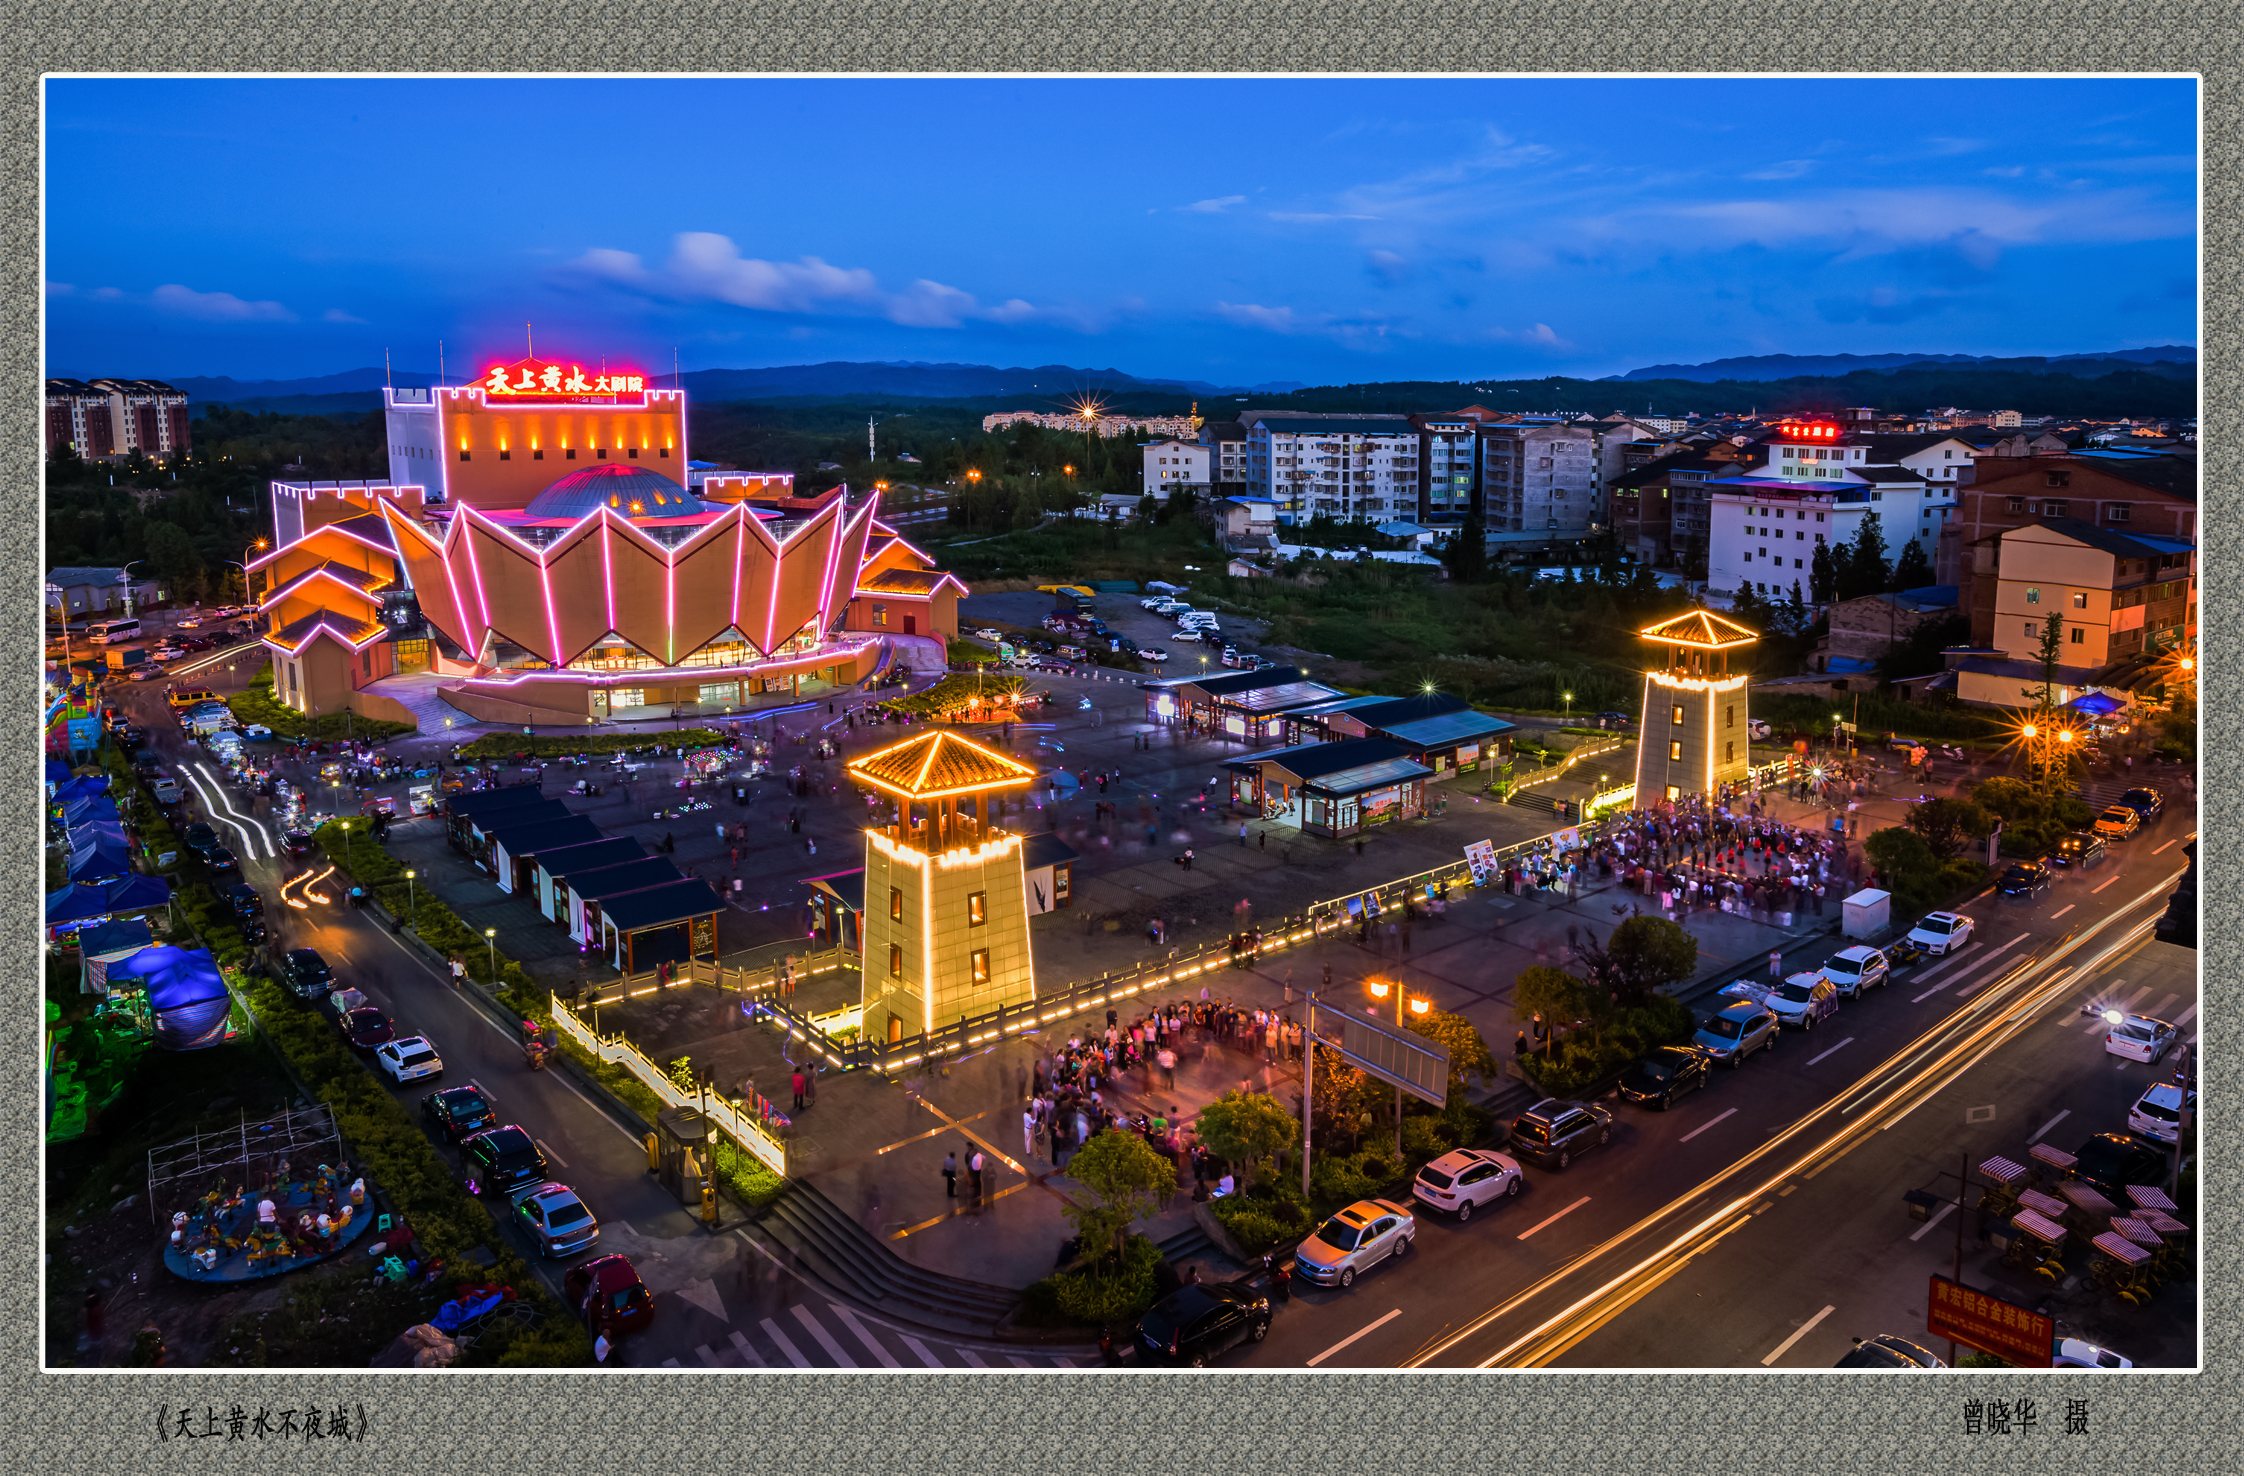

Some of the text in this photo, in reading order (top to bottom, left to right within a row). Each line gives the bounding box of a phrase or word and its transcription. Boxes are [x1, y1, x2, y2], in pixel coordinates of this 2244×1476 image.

[1937, 1282, 2045, 1337] 黄宏铝合金装饰行
